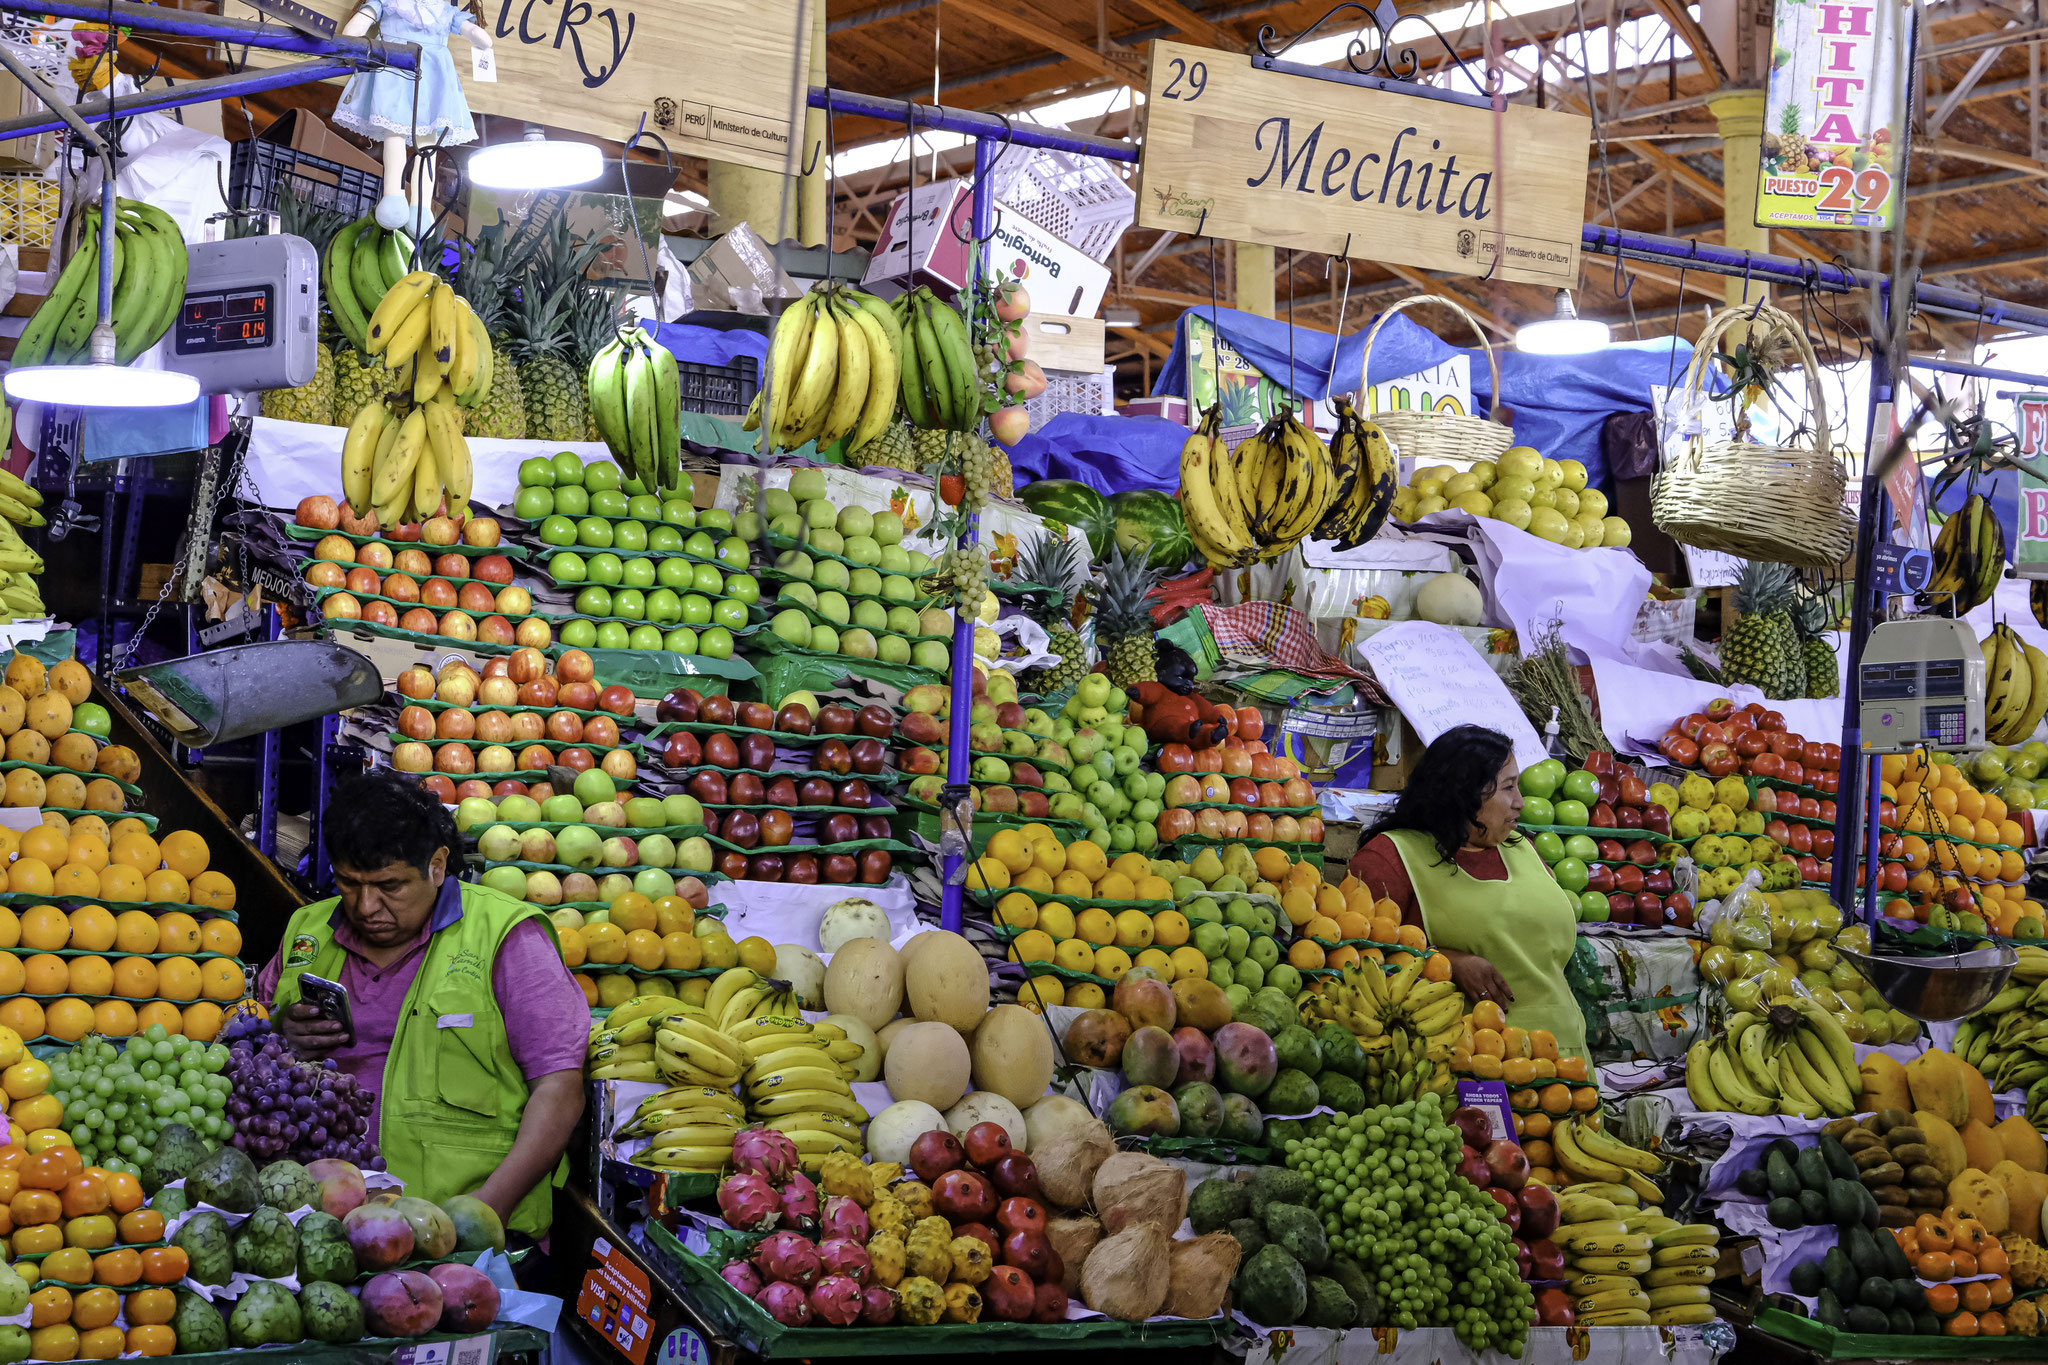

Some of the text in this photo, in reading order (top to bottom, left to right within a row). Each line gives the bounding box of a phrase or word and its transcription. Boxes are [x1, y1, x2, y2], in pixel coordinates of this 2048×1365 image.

[457, 0, 635, 88] icky
[1162, 58, 1208, 101] 29
[685, 113, 706, 126] PERÚ
[713, 119, 788, 143] Ministerio de Cultura
[1247, 117, 1493, 221] Mechita
[1766, 166, 1891, 213] PUESTO 29
[1769, 212, 1814, 221] ACEPTAMOS
[995, 228, 1061, 279] Battaglio
[1506, 246, 1569, 264] Ministerio de Cultura
[1234, 357, 1250, 371] 28
[590, 1279, 606, 1301] VISA
[604, 1261, 647, 1301] Aceptamos todas
